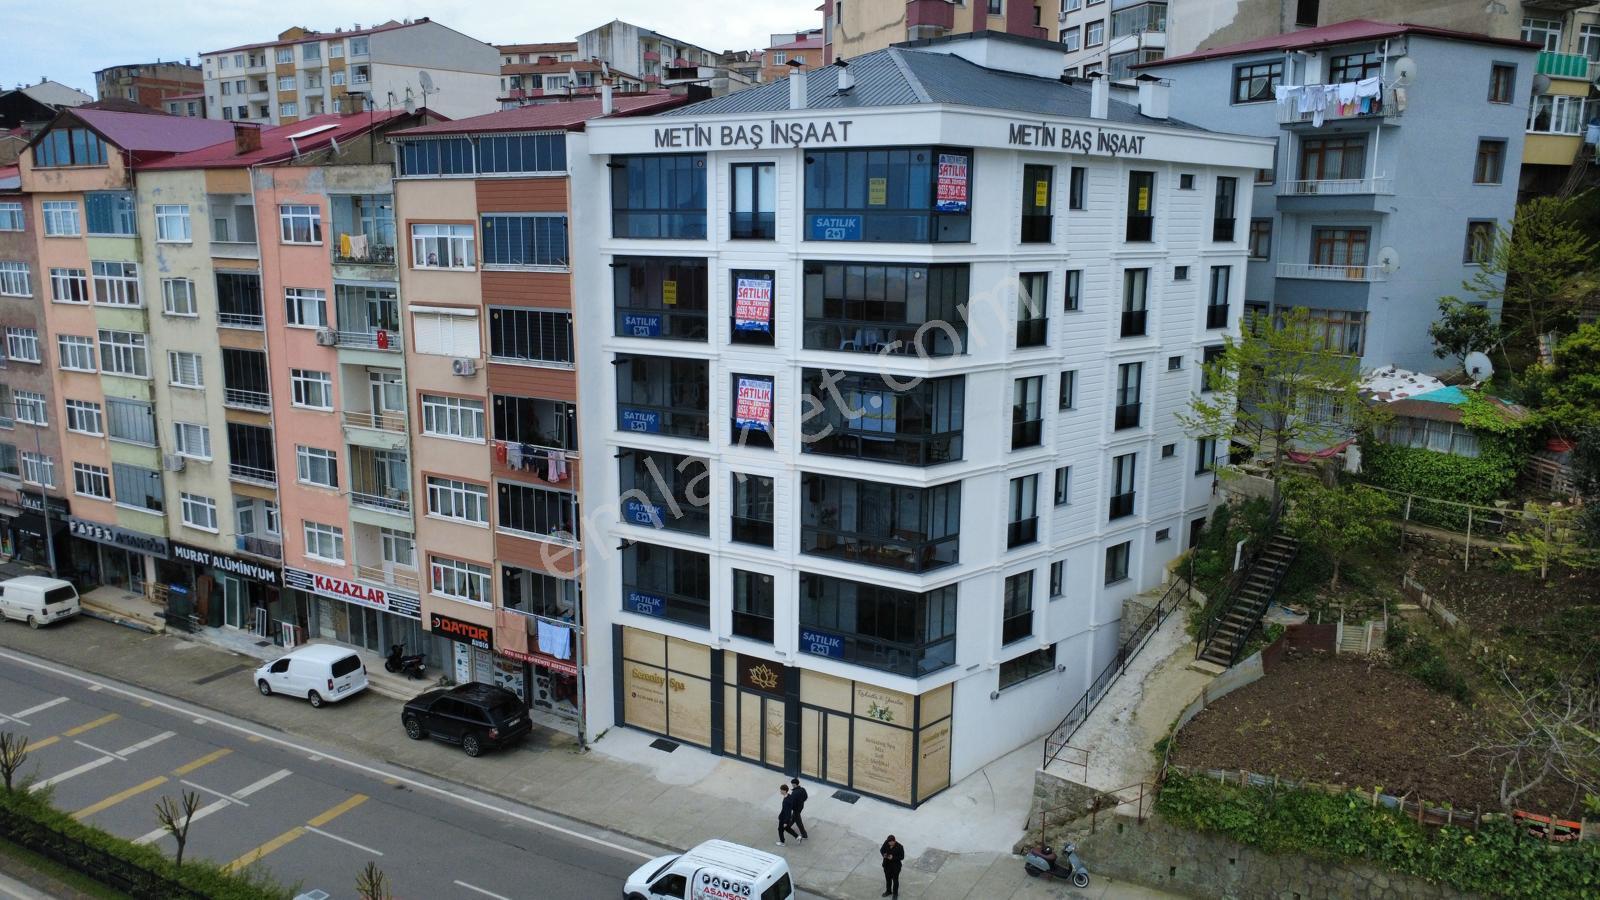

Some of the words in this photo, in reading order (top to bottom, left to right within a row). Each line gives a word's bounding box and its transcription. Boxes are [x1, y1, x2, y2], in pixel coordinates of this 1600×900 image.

[654, 123, 712, 148] METİN
[720, 124, 763, 150] BAŞ
[770, 120, 853, 148] İNŞAAT
[1008, 121, 1056, 146] METİN
[1061, 128, 1092, 154] BAŞ
[1097, 128, 1146, 156] İNŞAAT
[939, 164, 966, 177] SATILIK
[816, 218, 856, 228] SATILIK
[826, 228, 845, 239] 2+1
[738, 287, 770, 300] SATILIK
[625, 316, 658, 326] SATILIK
[634, 326, 649, 336] 3+1
[739, 387, 770, 400] SATILIK
[624, 411, 656, 423] SATILIK
[632, 421, 646, 431] 3+1
[637, 513, 651, 522] 3+1
[69, 521, 113, 541] FATEX
[175, 546, 210, 565] MURAT
[213, 556, 276, 582] ALÜMİNYUM
[315, 575, 385, 604] KAZAZLAR
[630, 593, 661, 607] SATILIK
[638, 603, 652, 613] 2+1
[441, 618, 489, 640] DATOR
[803, 632, 840, 647] SATILIK
[812, 643, 828, 654] 2+1
[632, 668, 665, 688] Serenity
[669, 677, 686, 692] Spa
[703, 874, 750, 896] FATEX
